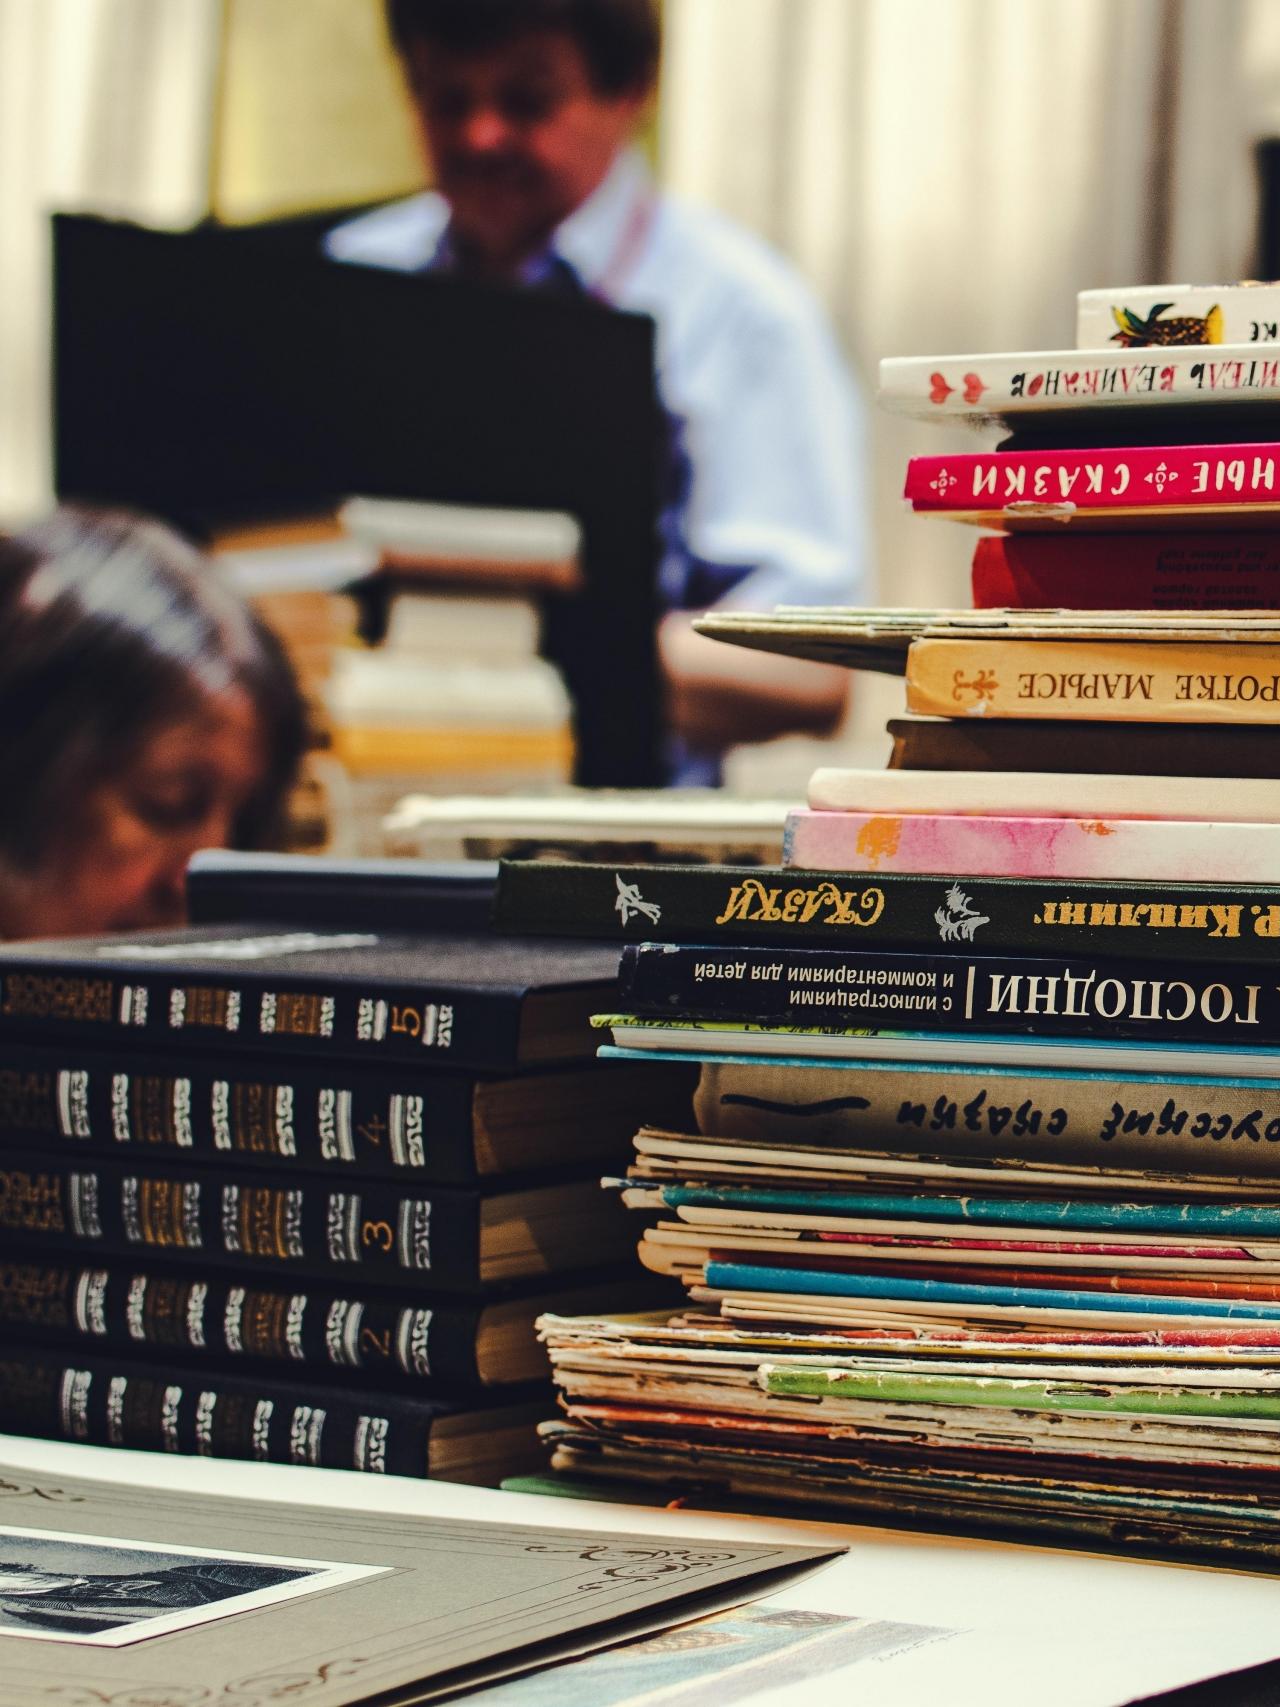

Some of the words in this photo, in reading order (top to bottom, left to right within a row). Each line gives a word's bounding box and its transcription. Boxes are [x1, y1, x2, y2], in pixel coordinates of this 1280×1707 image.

[970, 463, 1132, 497] СКАЗКИ
[1018, 672, 1155, 704] МАРЫСЕ
[715, 880, 885, 928] СКАЗКИ
[1034, 902, 1244, 937] Киплинг
[695, 962, 746, 981] детей
[752, 964, 782, 981] для
[788, 966, 936, 988] комментариями
[943, 974, 954, 988] и
[790, 989, 936, 1009] иллюстрациями
[943, 997, 952, 1010] с
[986, 968, 1264, 1028] ГОСПОДНИ
[392, 1006, 423, 1037] 5
[893, 1094, 1069, 1135] сказки
[363, 1219, 393, 1252] 3
[362, 1328, 391, 1357] 2
